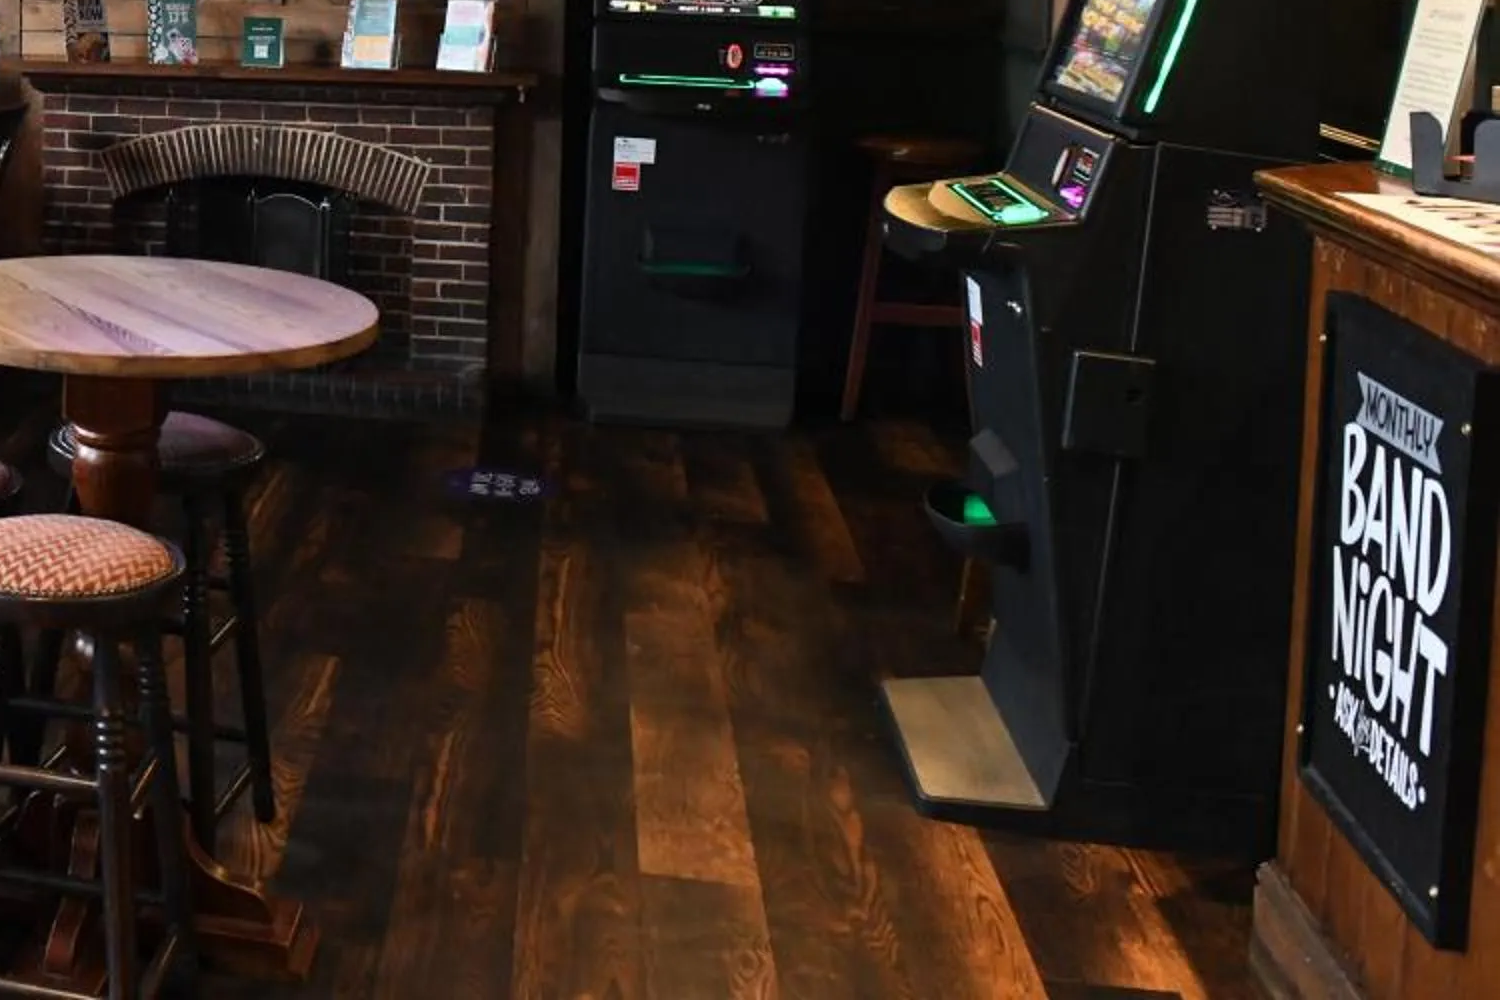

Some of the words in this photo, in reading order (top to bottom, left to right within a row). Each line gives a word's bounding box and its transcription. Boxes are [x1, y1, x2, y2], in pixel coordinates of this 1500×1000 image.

[1365, 382, 1436, 458] MONTHLY
[1340, 421, 1451, 617] BAND
[1369, 718, 1419, 811] DETAILS
